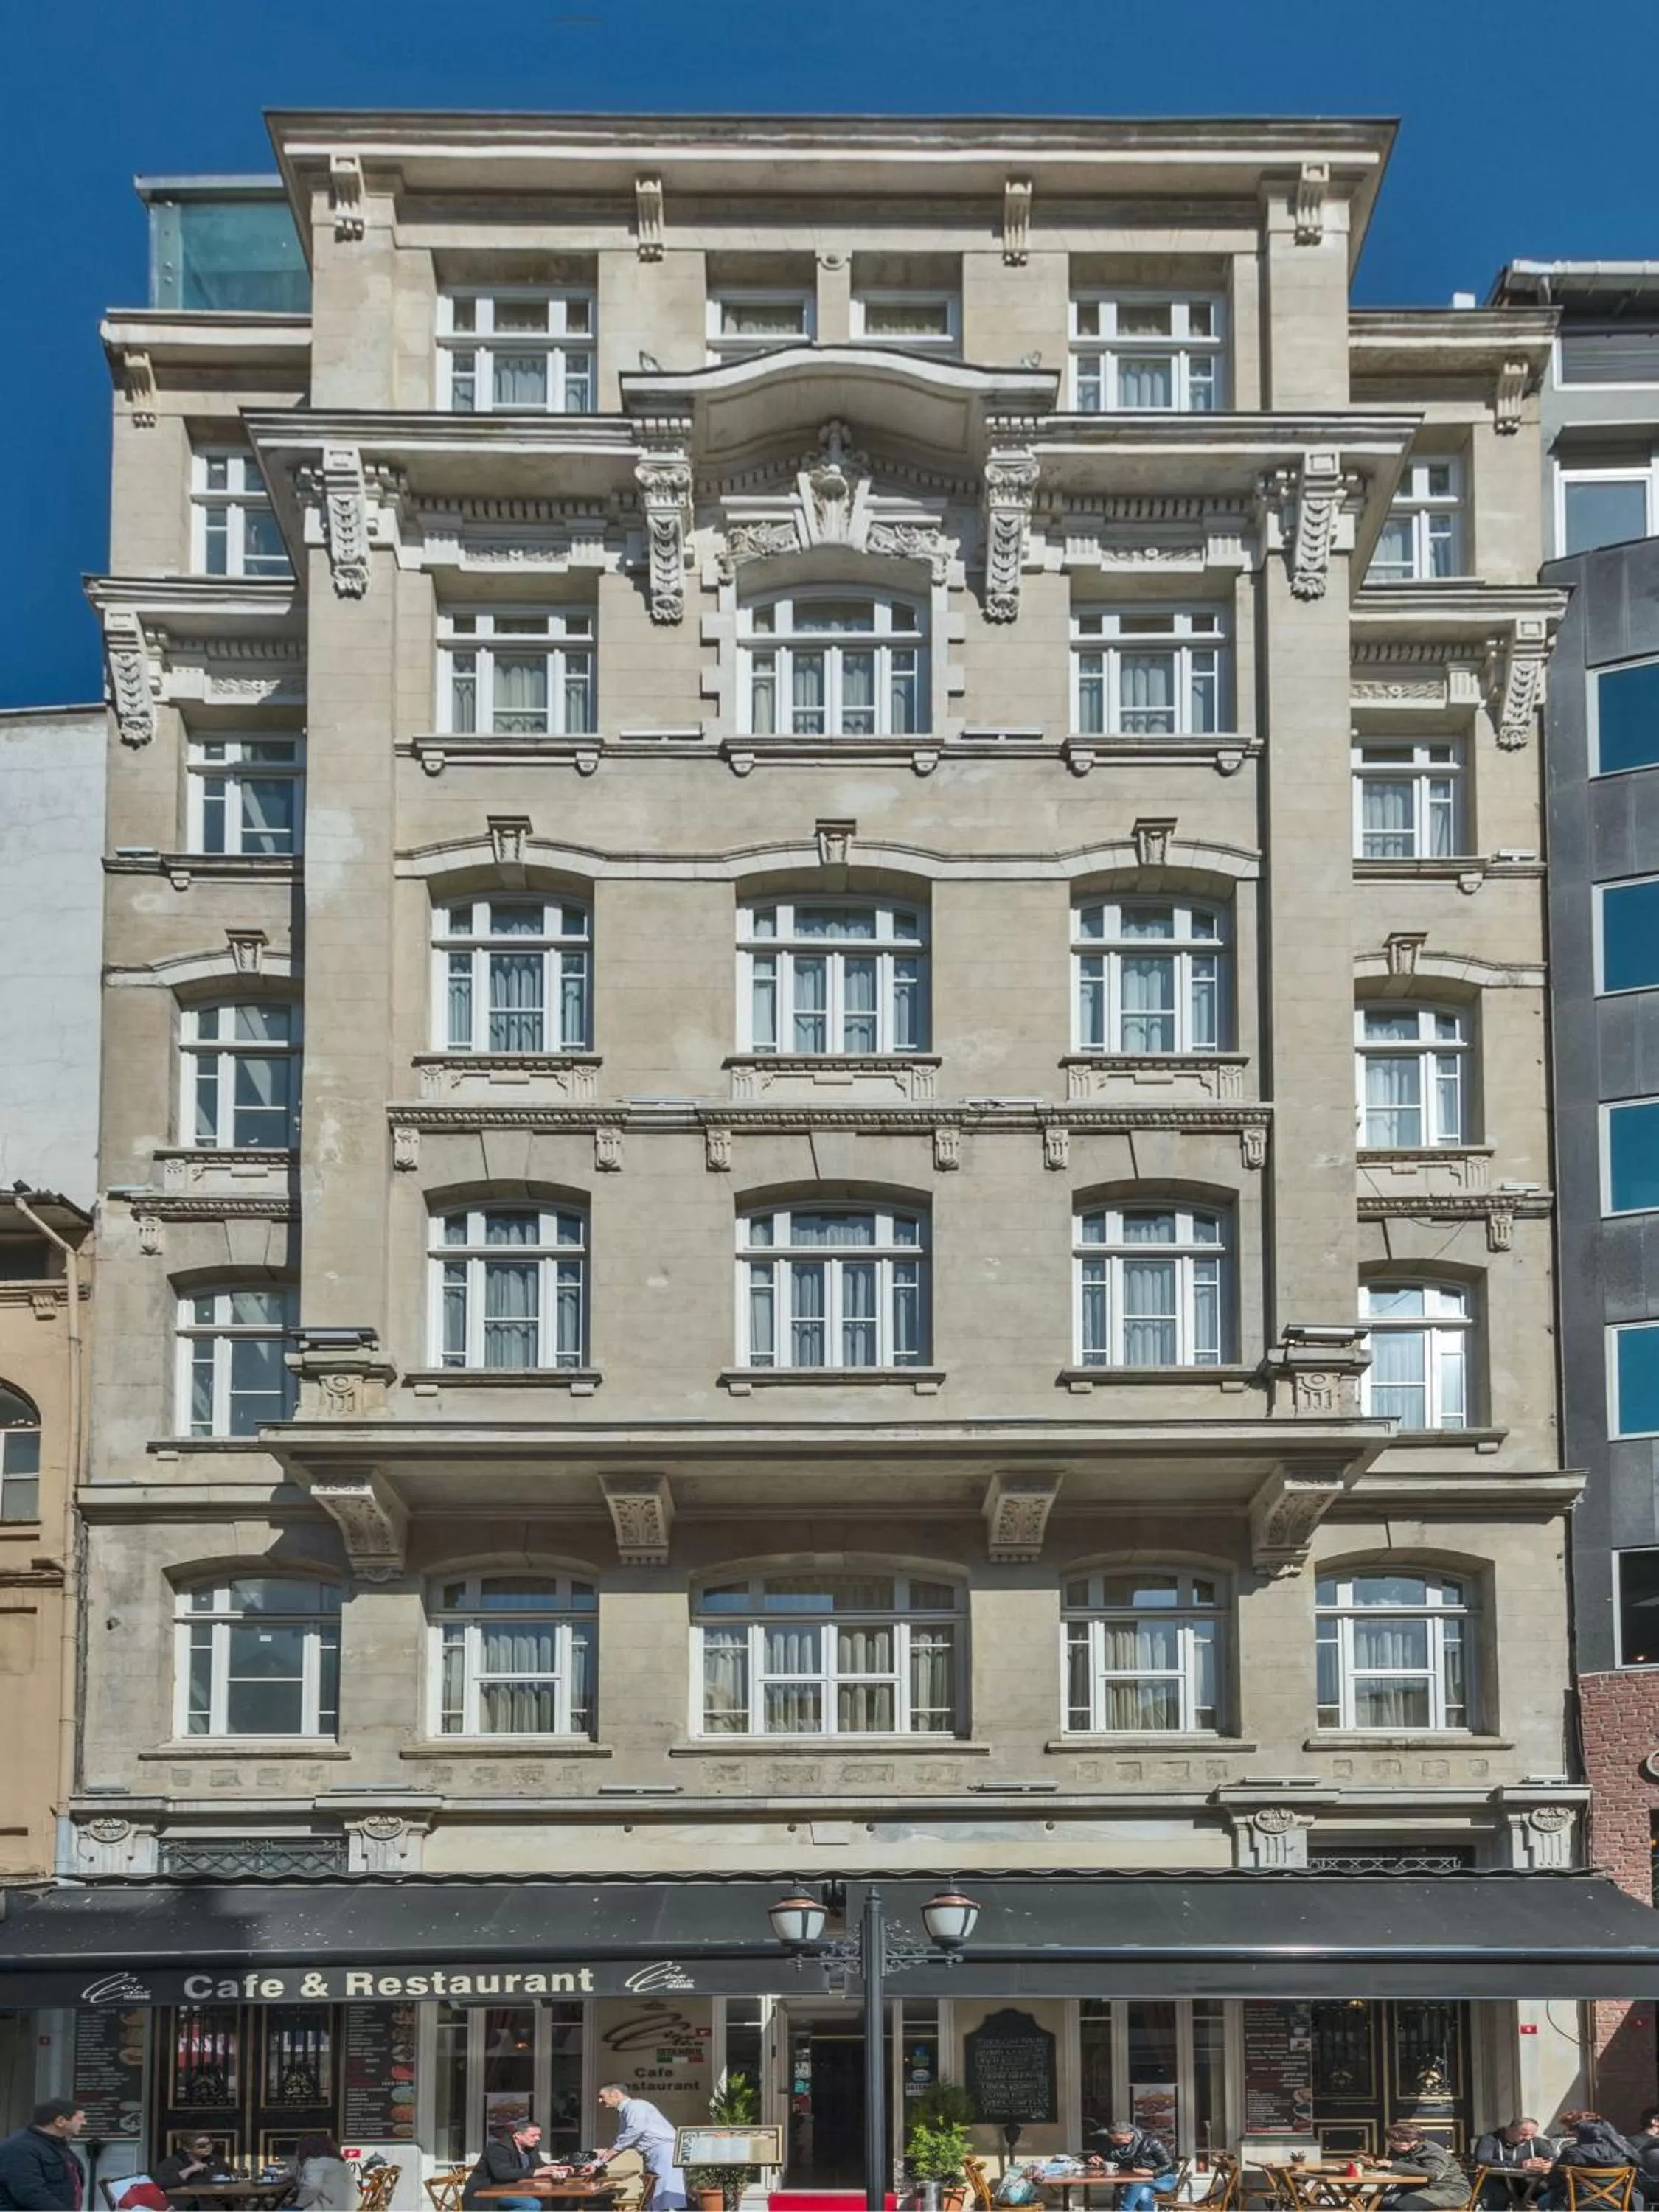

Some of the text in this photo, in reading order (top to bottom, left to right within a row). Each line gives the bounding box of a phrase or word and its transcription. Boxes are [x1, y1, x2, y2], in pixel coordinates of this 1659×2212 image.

[184, 1968, 594, 1999] Cafe & Restaurant
[634, 2067, 673, 2078] Cafe
[626, 2081, 700, 2091] staurant
